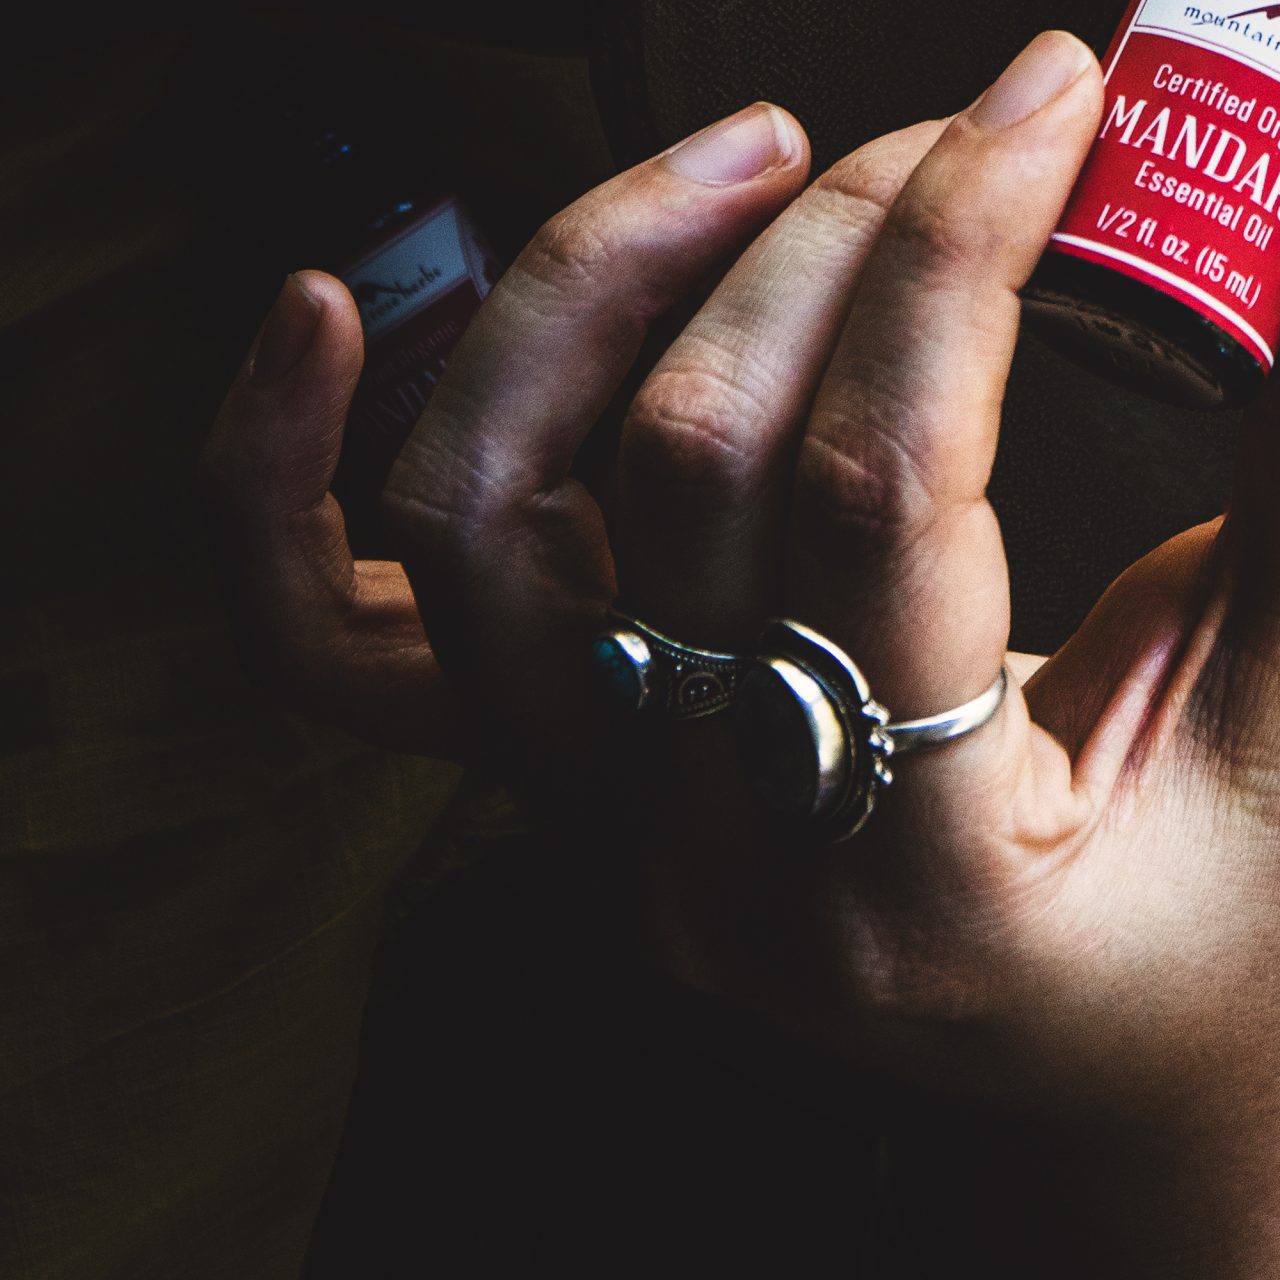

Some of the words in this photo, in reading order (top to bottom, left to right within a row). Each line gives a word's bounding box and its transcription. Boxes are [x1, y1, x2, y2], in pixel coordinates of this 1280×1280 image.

[1152, 63, 1257, 123] Certified
[1134, 160, 1244, 232] Essential
[1243, 214, 1274, 252] Oil
[1096, 203, 1138, 238] 1/2
[1135, 217, 1158, 249] fl.
[1161, 234, 1189, 265] oz.
[1194, 246, 1228, 283] (15
[1224, 271, 1263, 309] mL)
